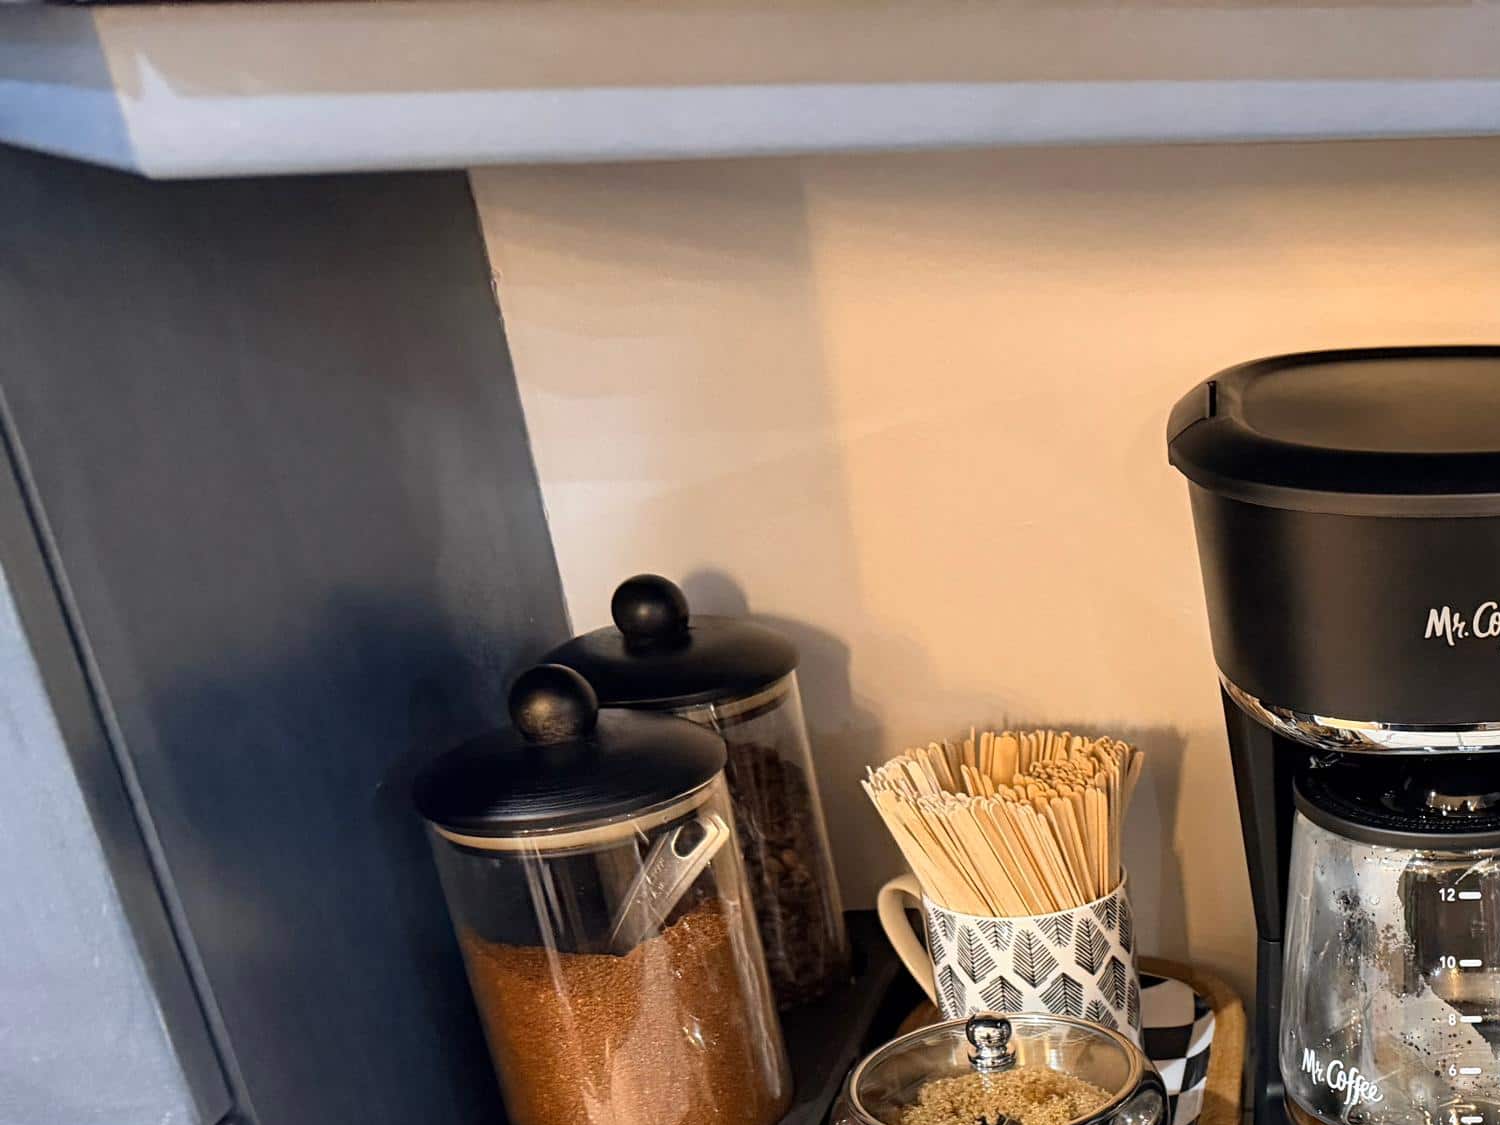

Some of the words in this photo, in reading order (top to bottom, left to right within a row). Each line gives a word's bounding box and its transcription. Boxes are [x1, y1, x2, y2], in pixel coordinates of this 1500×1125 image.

[1424, 606, 1469, 646] Mr.
[1439, 888, 1456, 902] 12
[1439, 956, 1456, 969] 10
[1448, 1014, 1457, 1027] 8
[1302, 1048, 1325, 1085] Mr.
[1326, 1060, 1384, 1105] Coffee
[1448, 1065, 1457, 1077] 6
